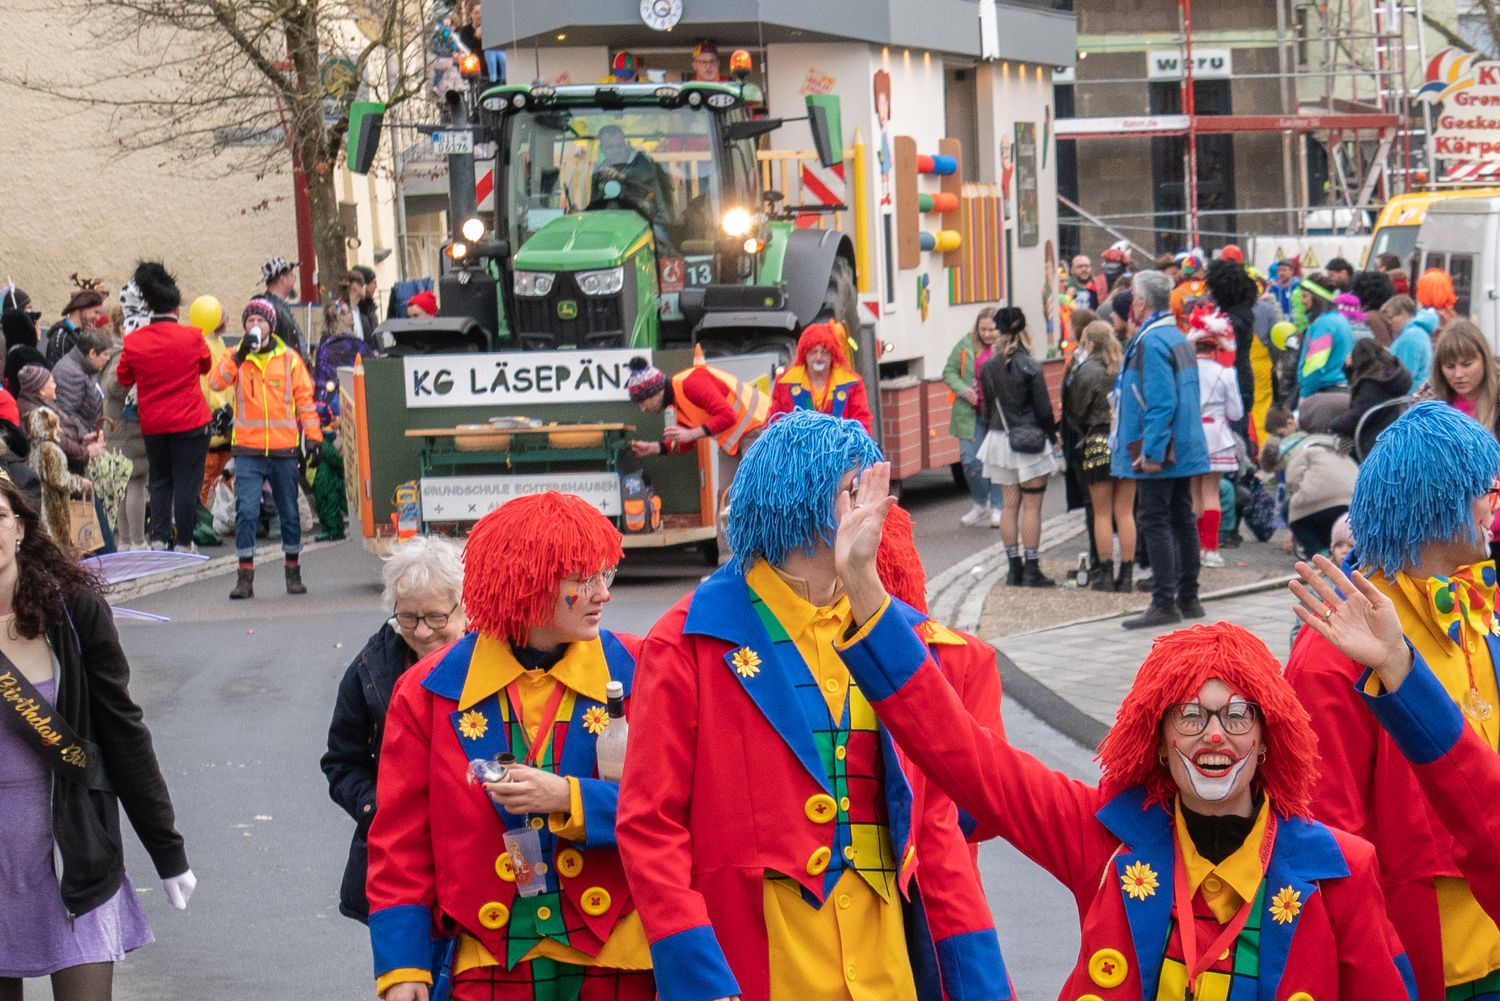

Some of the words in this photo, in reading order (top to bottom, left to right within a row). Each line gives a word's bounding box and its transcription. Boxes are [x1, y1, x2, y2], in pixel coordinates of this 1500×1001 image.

[687, 264, 712, 285] 13
[413, 369, 454, 397] KG
[423, 480, 510, 498] GRUNDSCHULE
